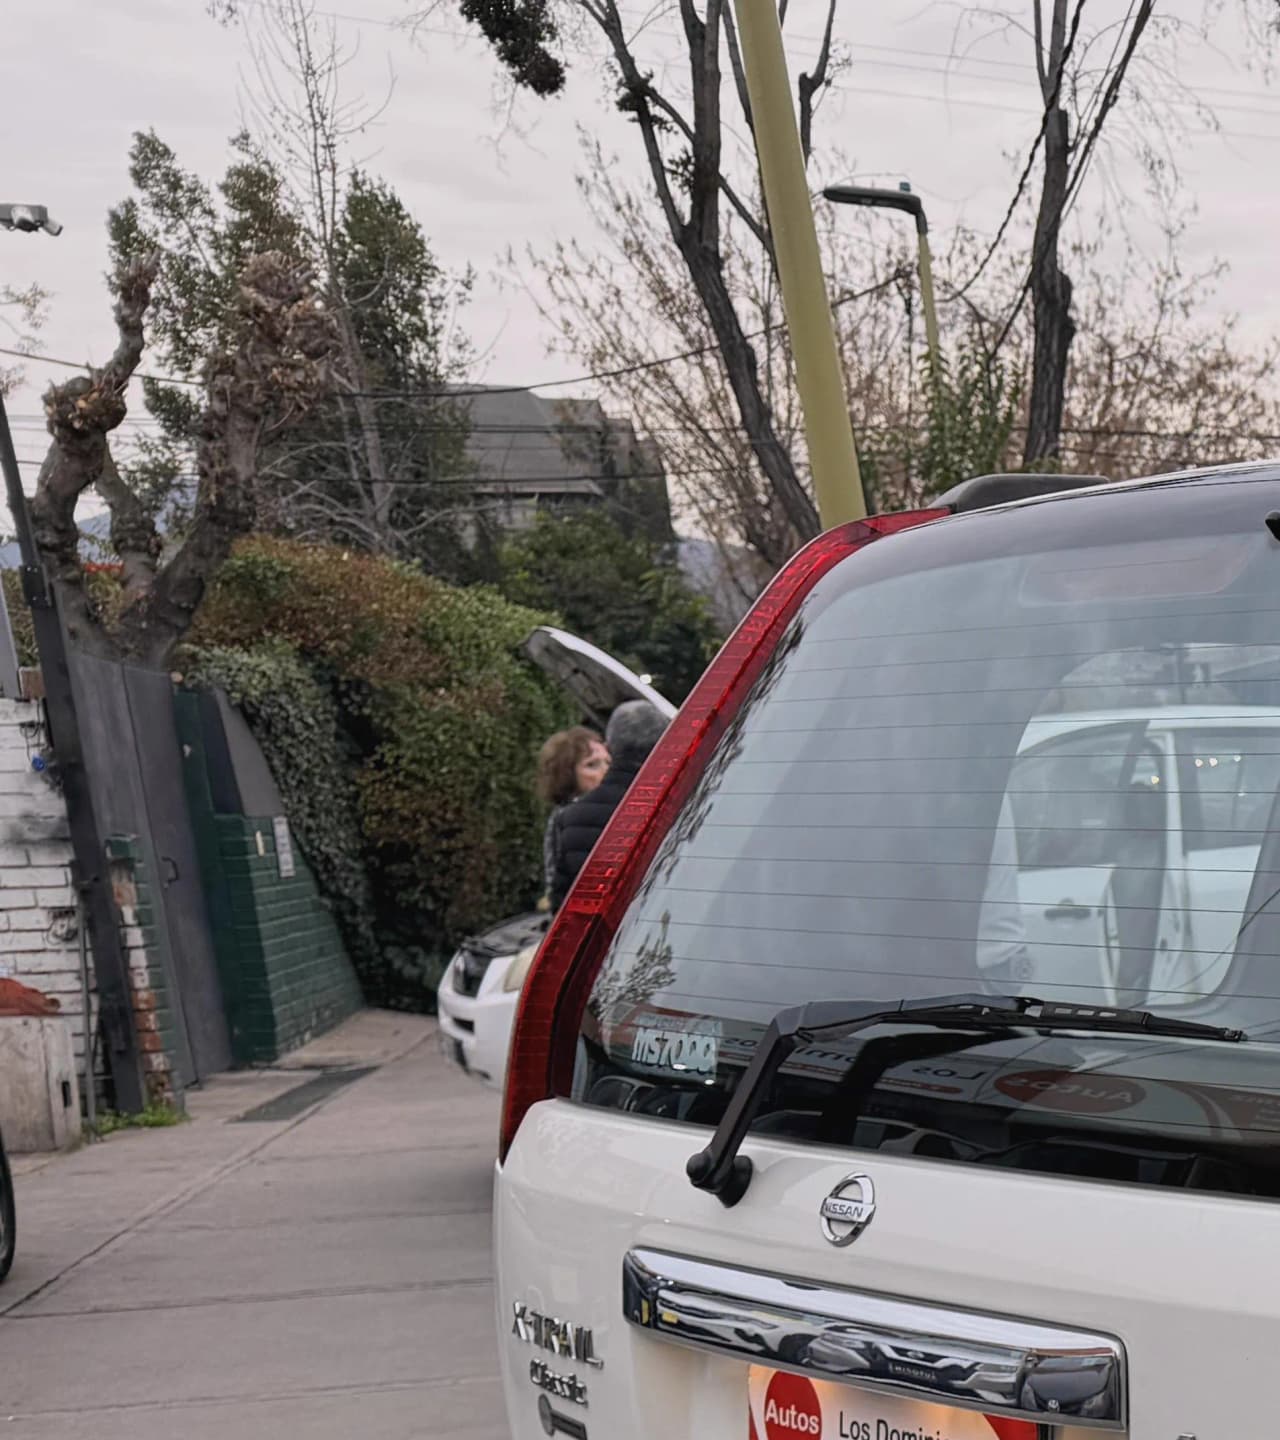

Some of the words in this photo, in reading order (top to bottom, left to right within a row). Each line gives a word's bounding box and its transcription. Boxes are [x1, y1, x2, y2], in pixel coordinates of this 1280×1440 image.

[825, 1202, 864, 1218] NISSAN
[512, 1301, 604, 1370] X-TRAIL
[764, 1398, 821, 1435] Autos
